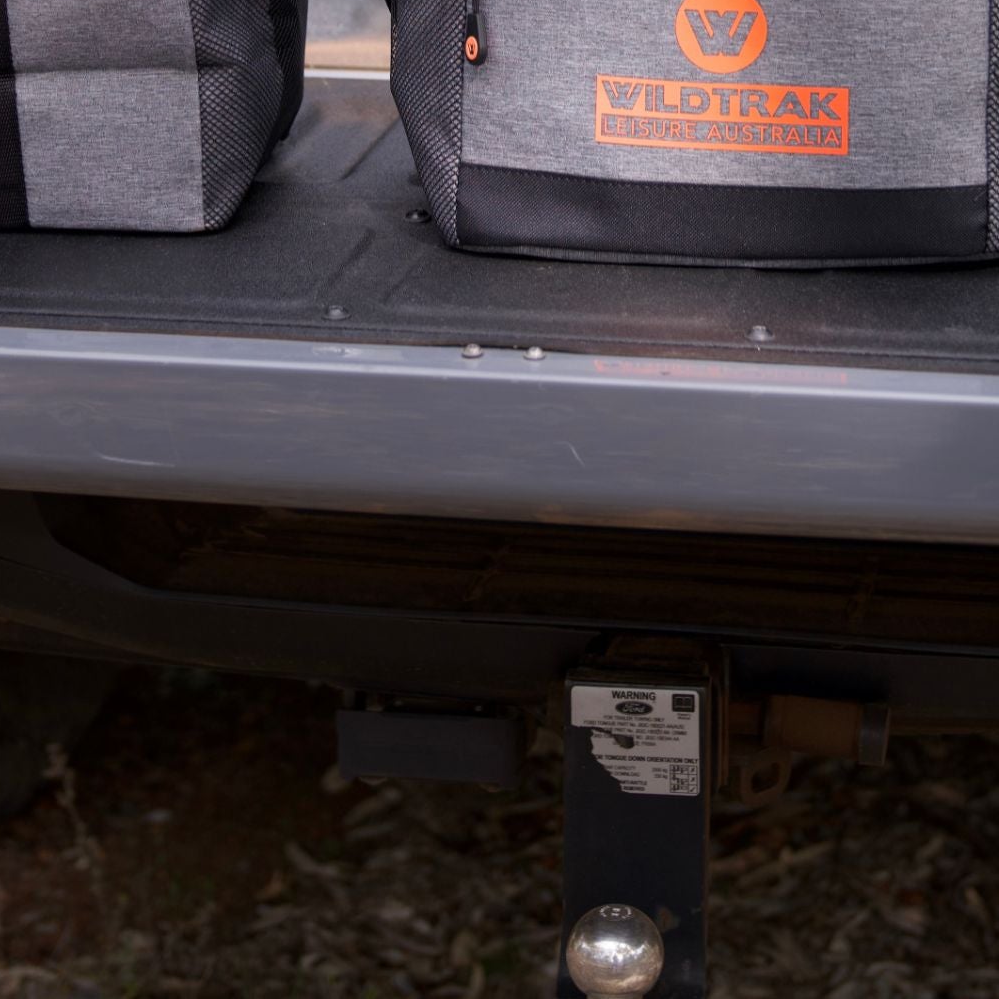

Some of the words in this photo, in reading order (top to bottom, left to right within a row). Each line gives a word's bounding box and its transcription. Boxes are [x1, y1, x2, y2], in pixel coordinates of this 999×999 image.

[602, 80, 841, 120] WILDTRAK
[603, 116, 696, 139] LEISURE
[707, 123, 841, 146] AUSTRALIA
[612, 690, 657, 701] WARNING
[621, 703, 647, 713] Ford
